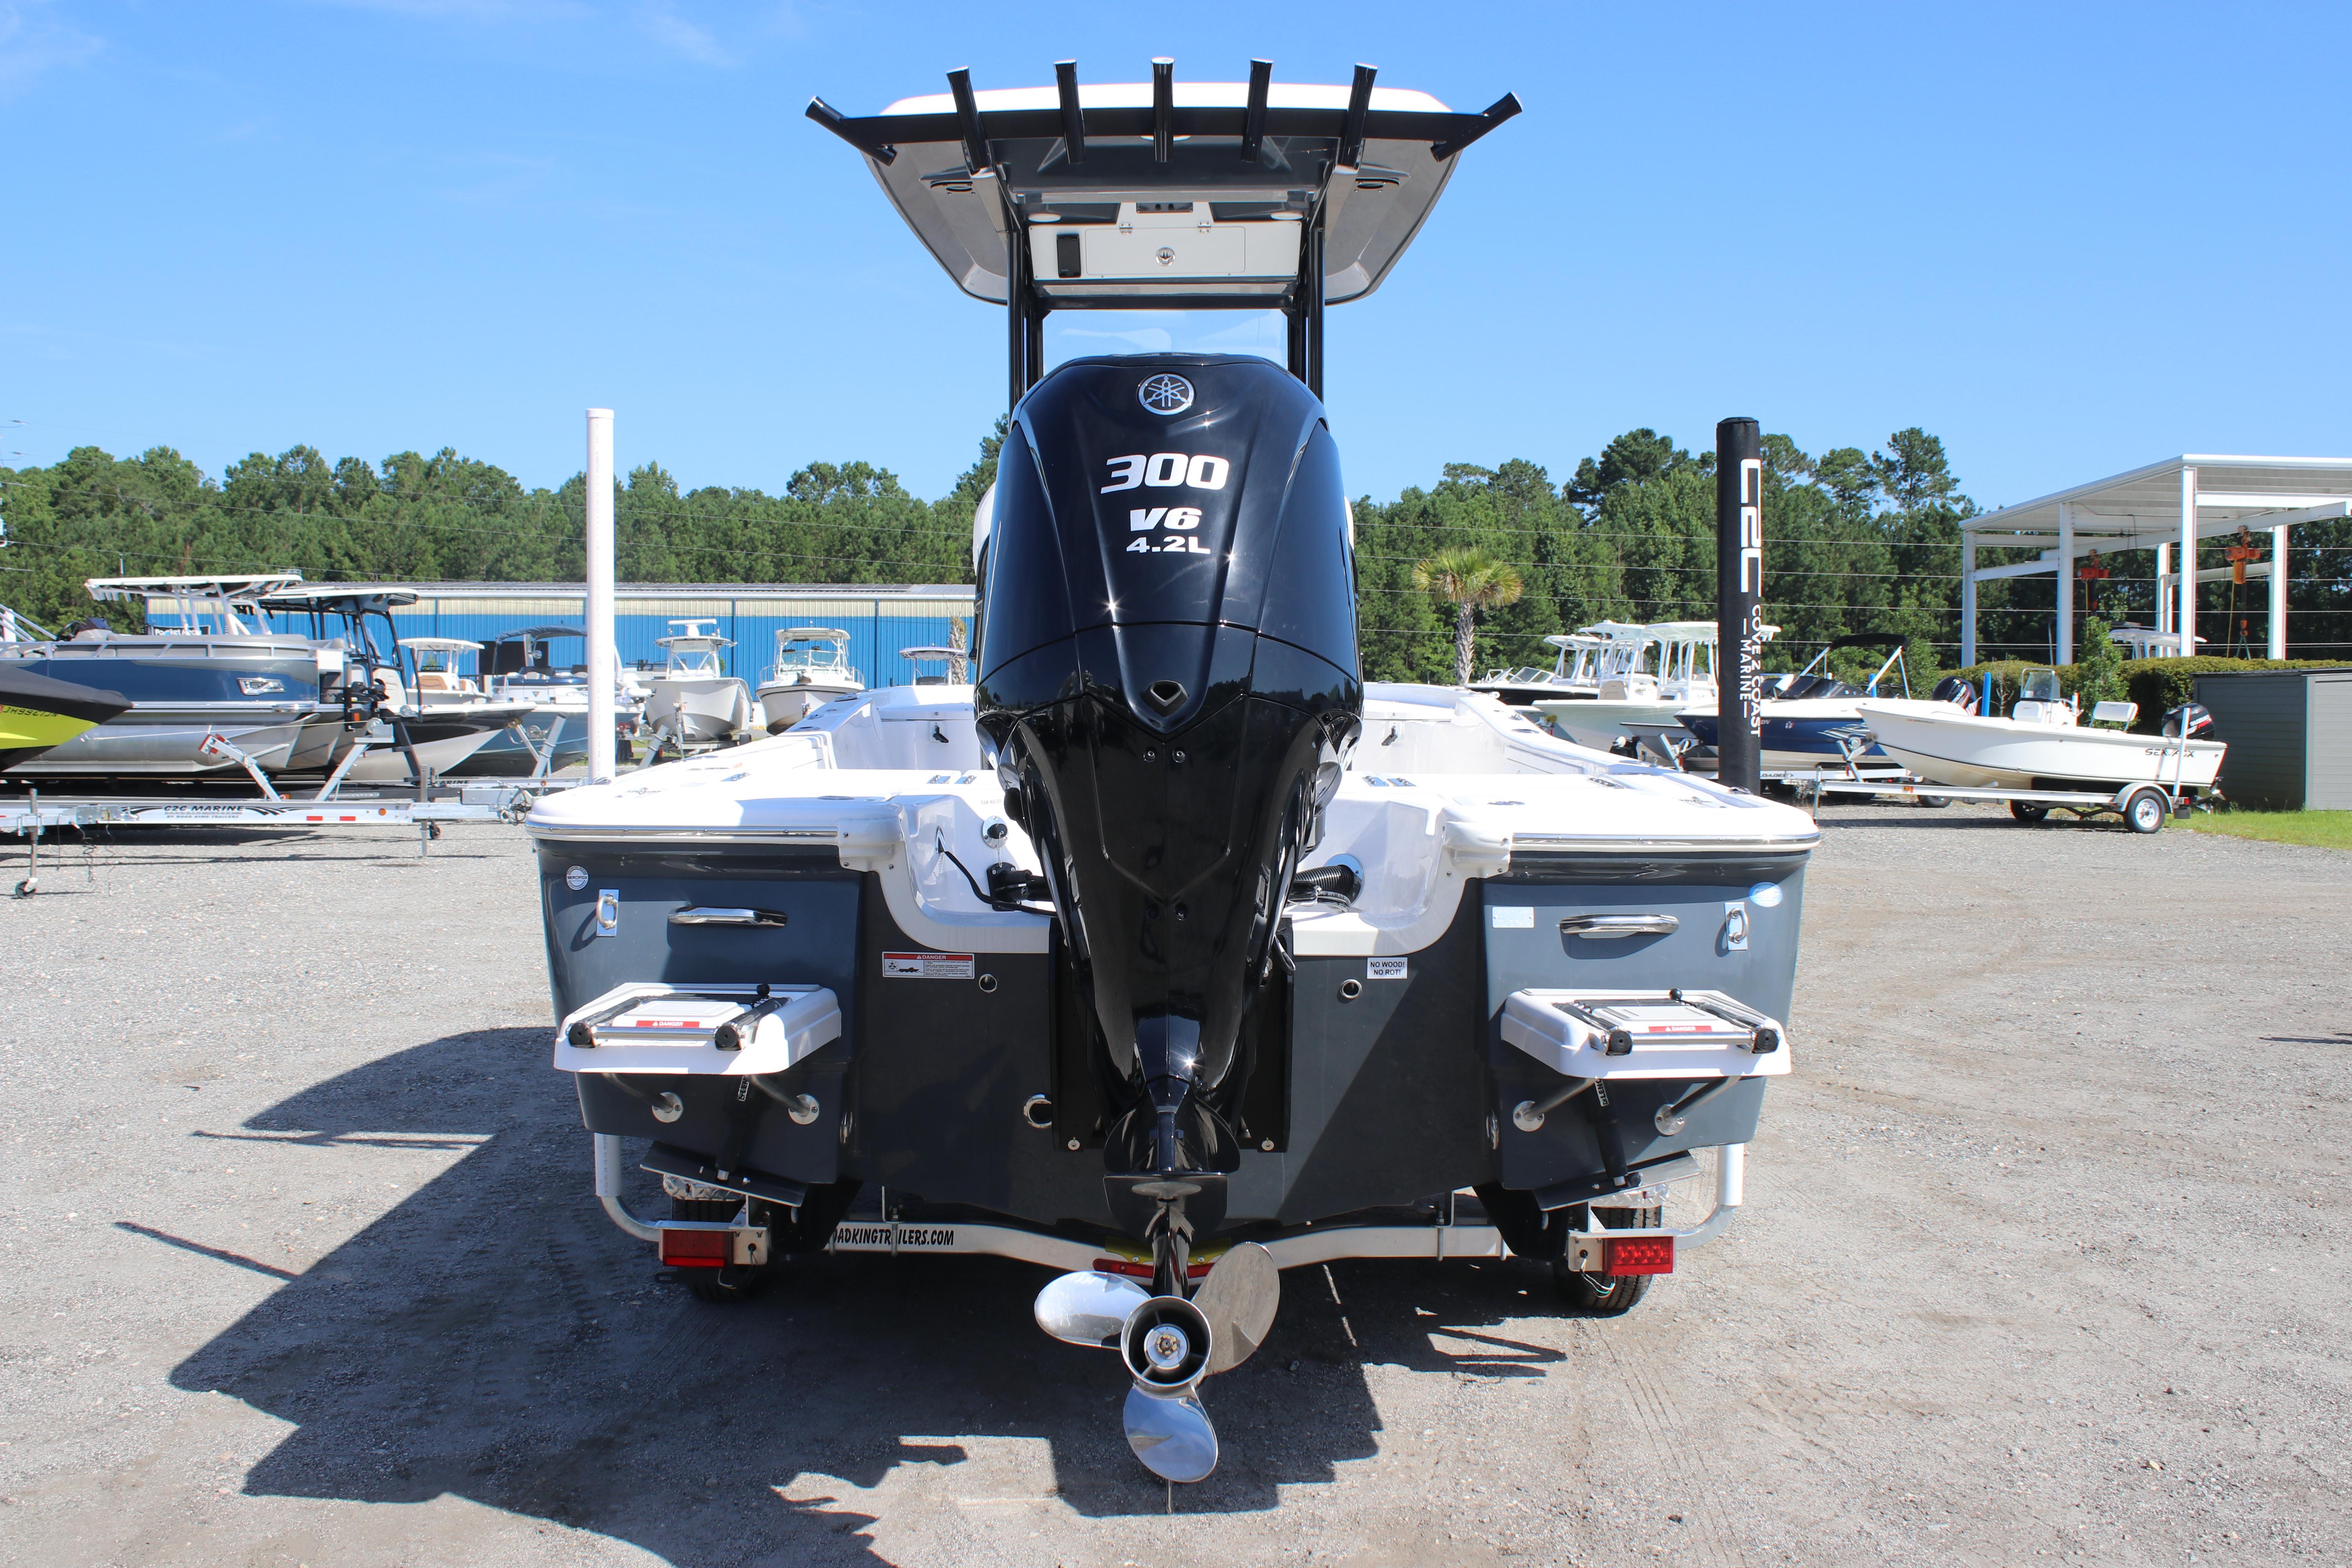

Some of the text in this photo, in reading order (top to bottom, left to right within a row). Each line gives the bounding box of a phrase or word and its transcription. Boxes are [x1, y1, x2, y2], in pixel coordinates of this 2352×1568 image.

[1100, 453, 1229, 494] 300
[1126, 535, 1211, 554] 4.2L
[1130, 507, 1202, 532] V6
[1740, 458, 1762, 597] C2C
[1740, 640, 1752, 700] MARINE
[1750, 604, 1761, 737] COVE 2 COAST
